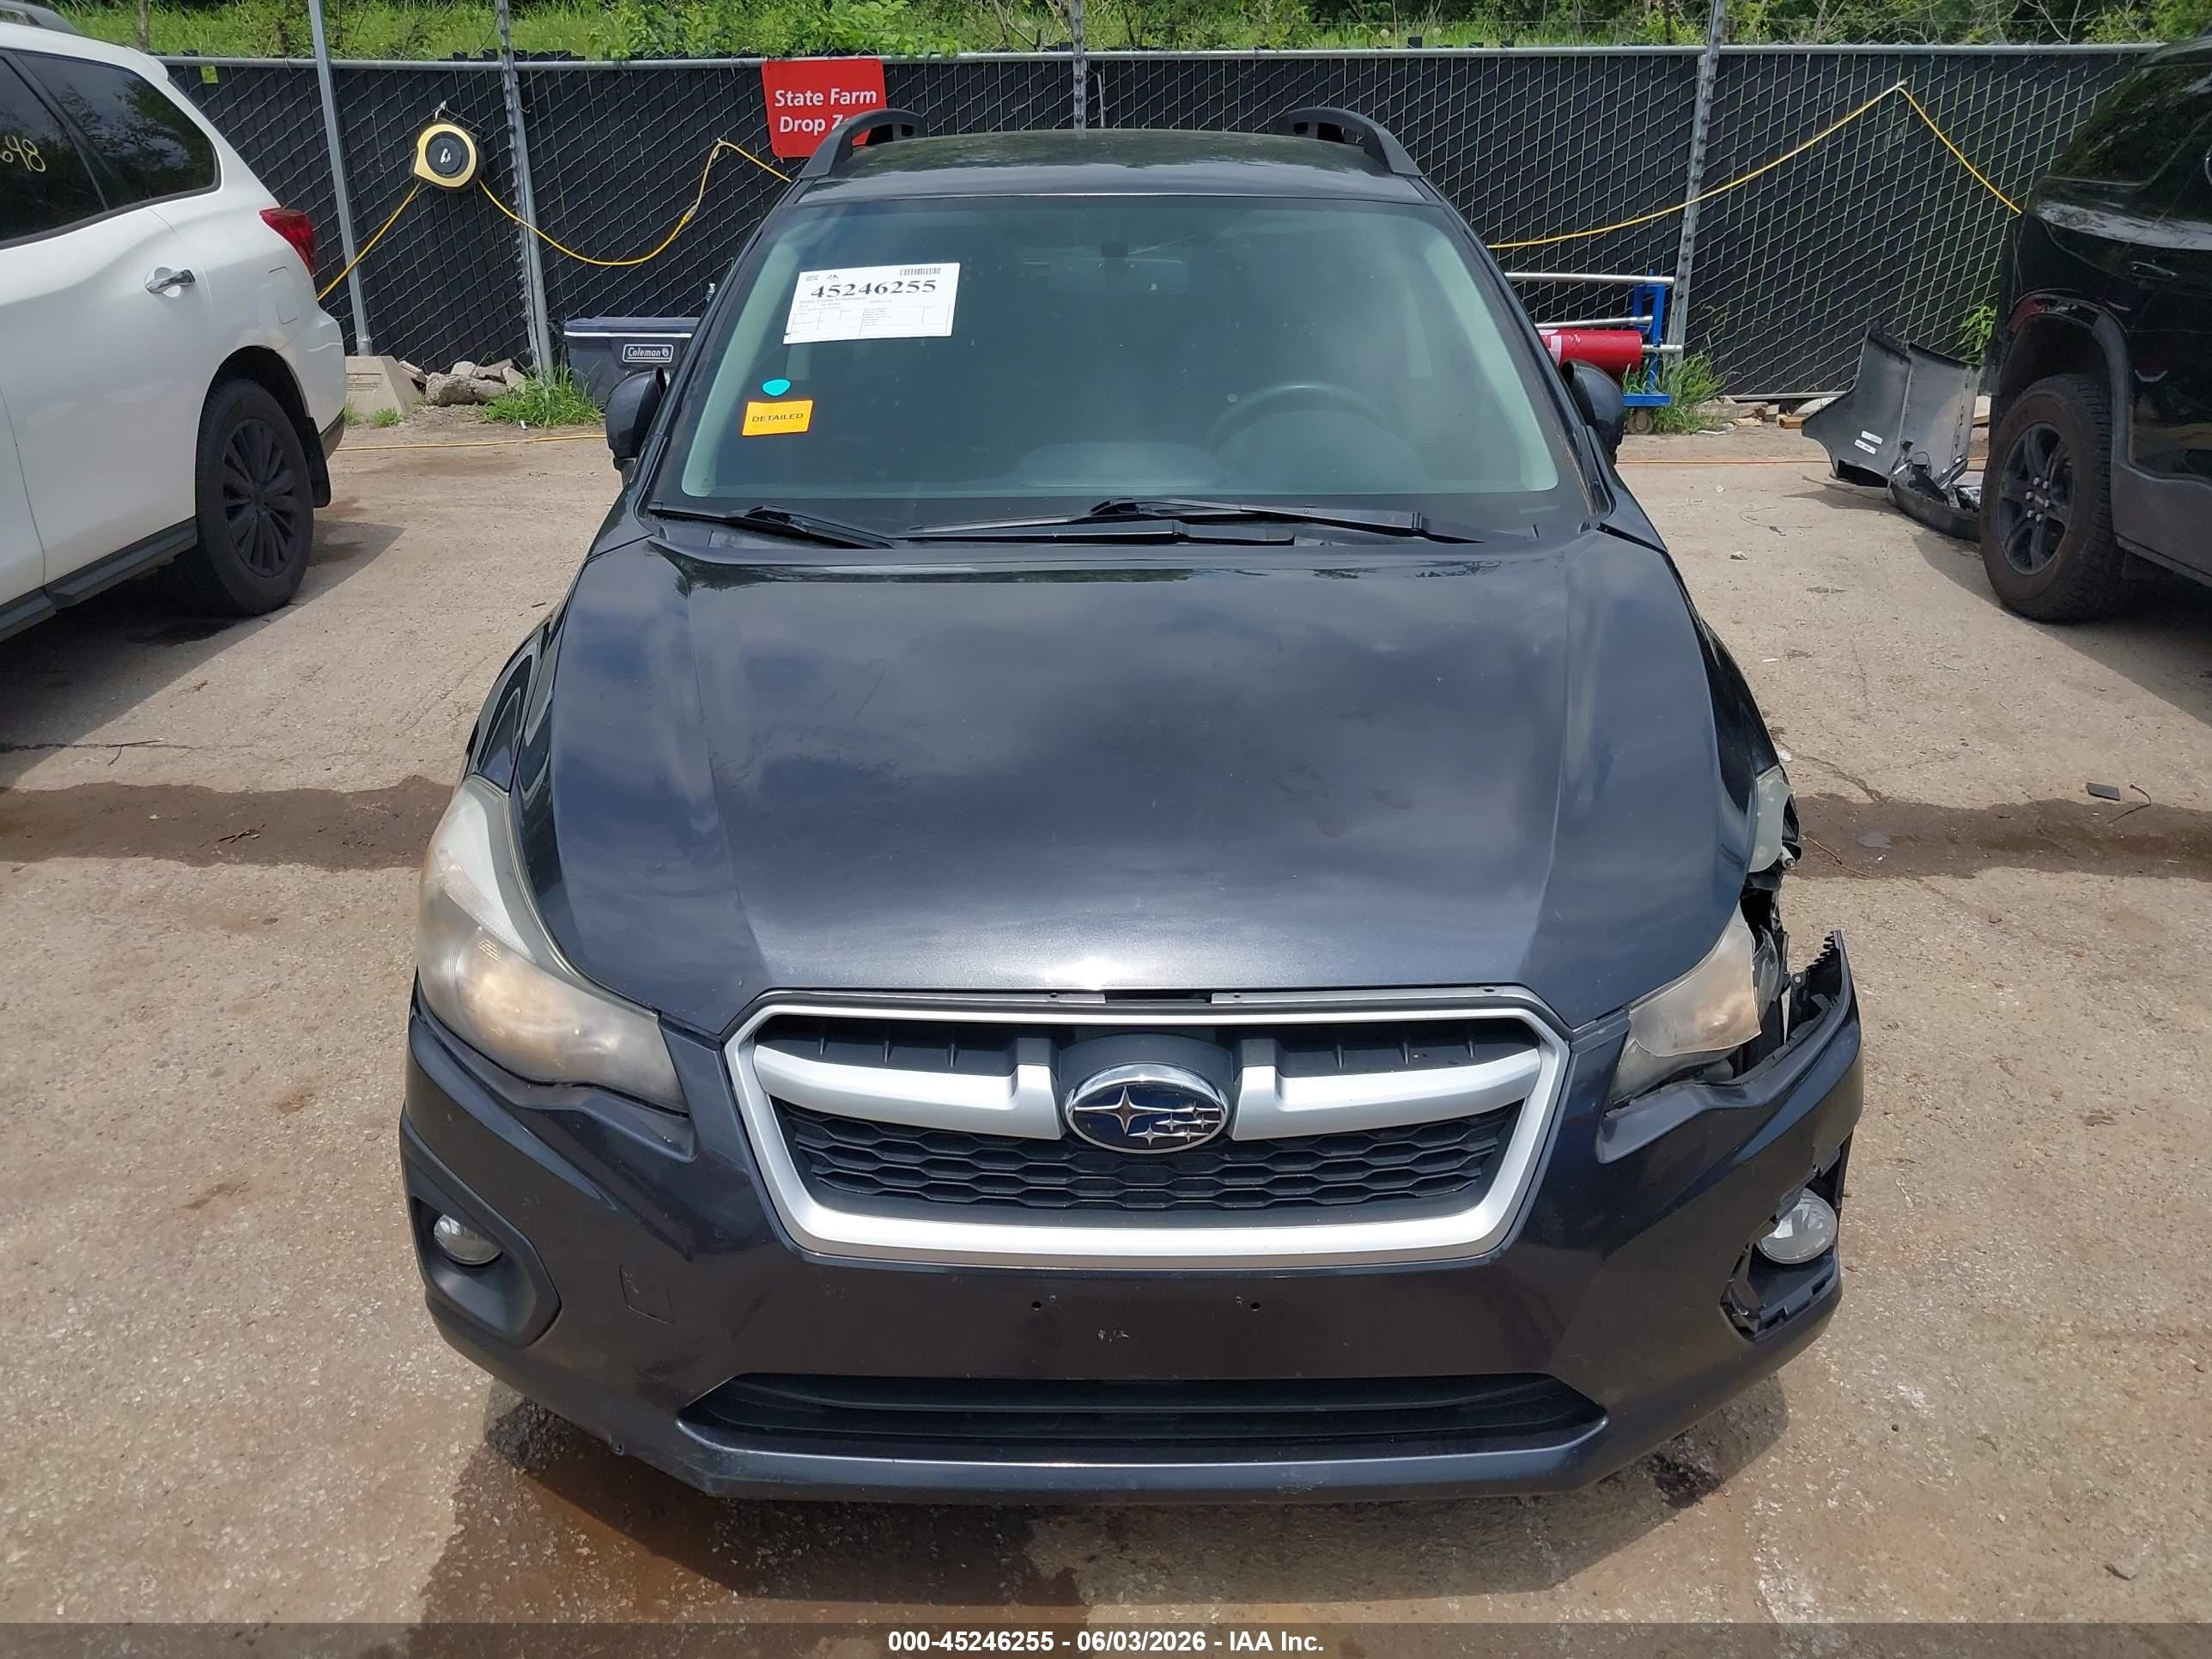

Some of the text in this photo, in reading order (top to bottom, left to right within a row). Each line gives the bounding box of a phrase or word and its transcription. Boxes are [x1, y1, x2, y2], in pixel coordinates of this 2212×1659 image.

[775, 88, 877, 107] State Farm
[779, 116, 826, 137] Drop
[811, 279, 937, 298] 45246255
[627, 347, 661, 357] Coleman
[751, 412, 804, 423] DETAILED
